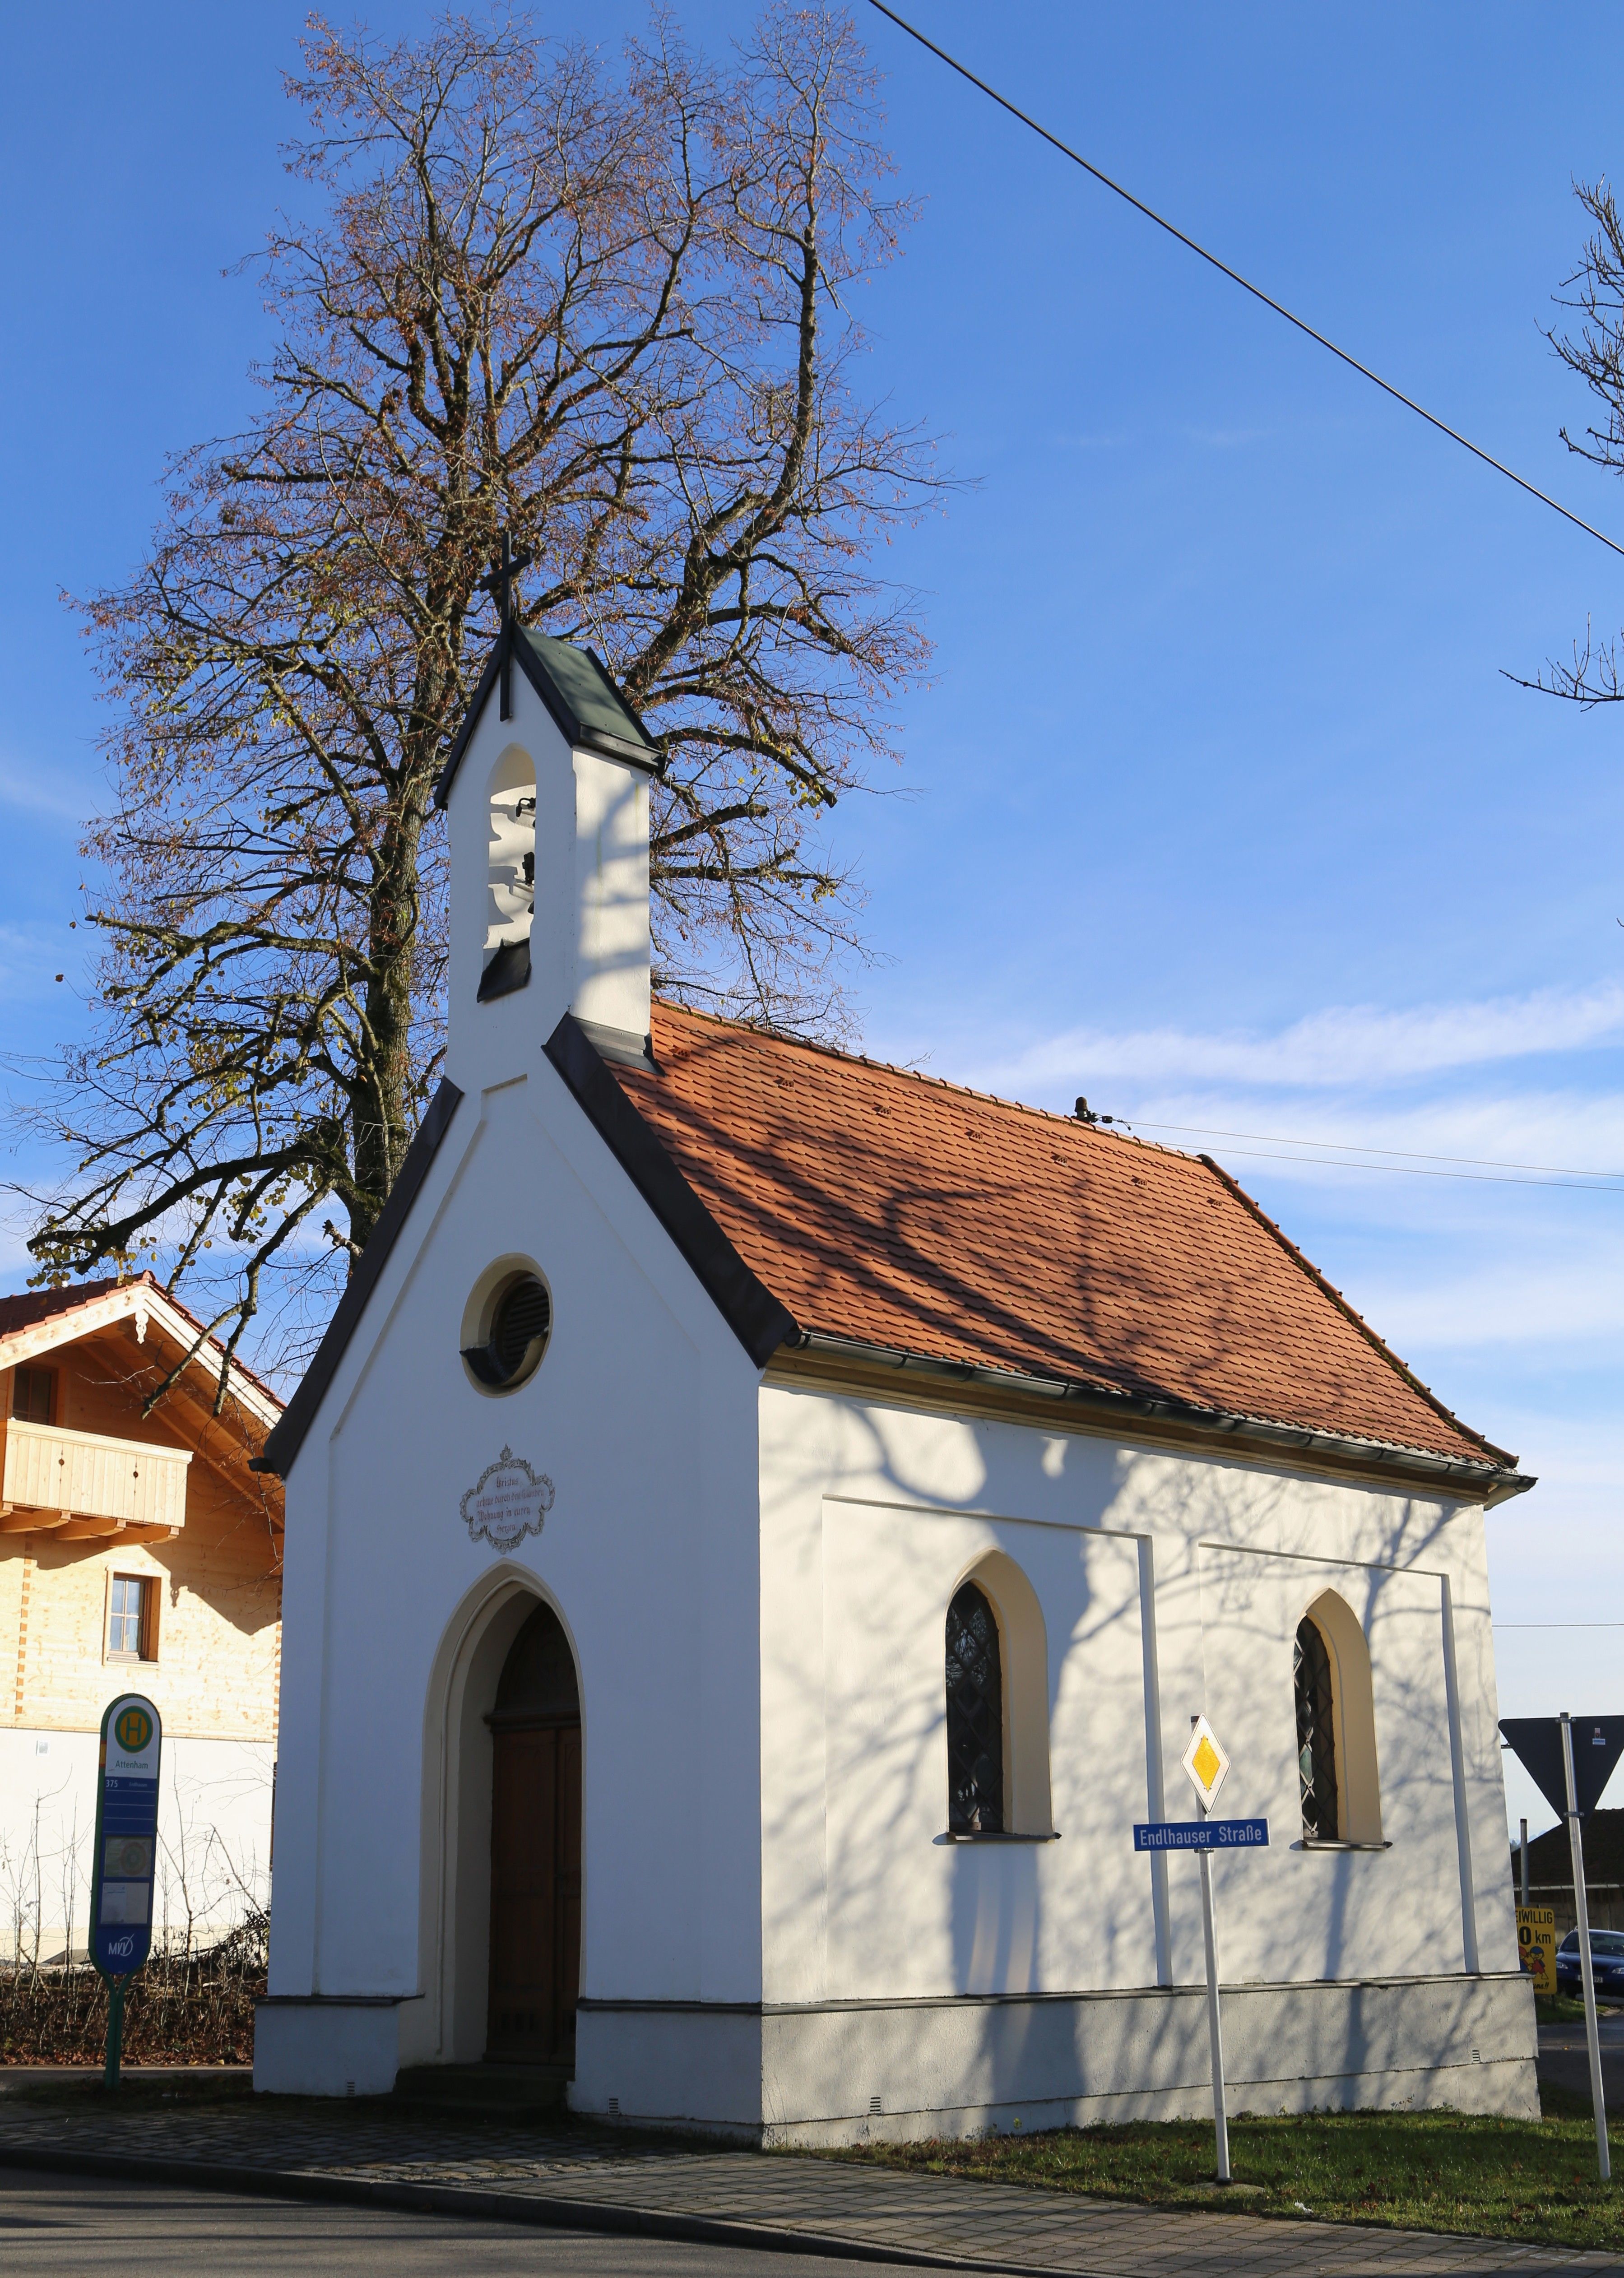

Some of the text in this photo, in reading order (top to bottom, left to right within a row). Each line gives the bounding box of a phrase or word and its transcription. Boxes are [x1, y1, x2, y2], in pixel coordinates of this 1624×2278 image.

[495, 1493, 510, 1503] durch
[511, 1491, 521, 1501] den
[477, 1509, 504, 1522] Wohnung
[506, 1507, 512, 1517] in
[126, 1717, 142, 1741] H
[116, 1760, 148, 1769] Attenham
[1140, 1825, 1262, 1846] Endlhauser Straße
[1535, 1930, 1551, 1944] km
[108, 1934, 135, 1956] MVV
